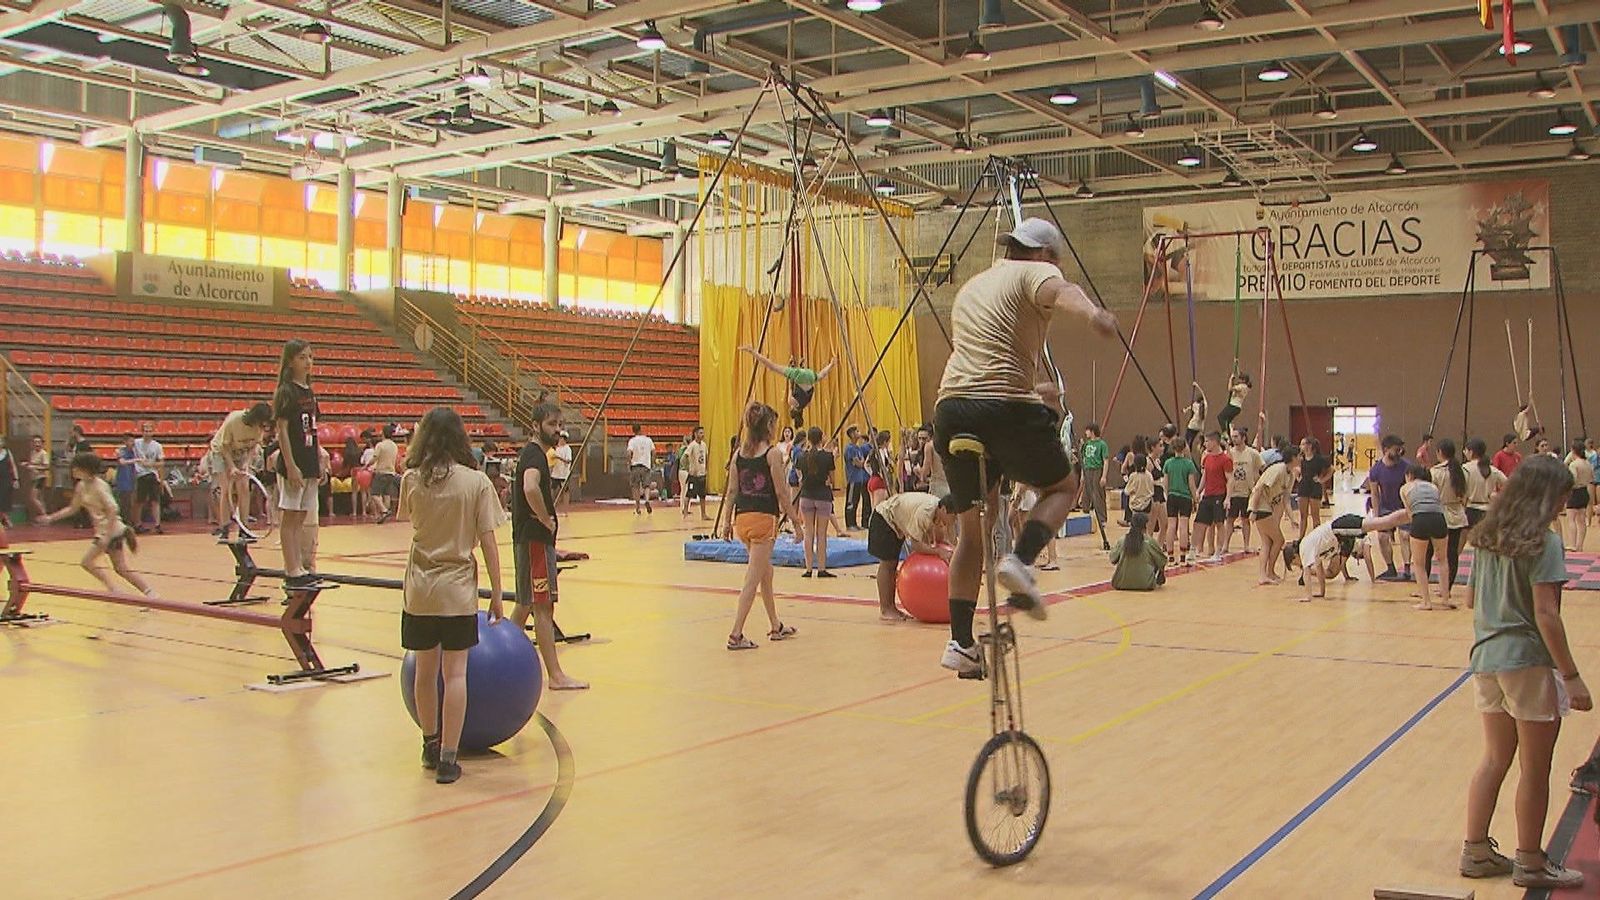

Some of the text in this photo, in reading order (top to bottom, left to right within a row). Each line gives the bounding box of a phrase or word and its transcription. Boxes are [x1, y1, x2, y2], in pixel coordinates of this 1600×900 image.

[1269, 200, 1418, 221] Ayuntamiento de Alcorcón
[1251, 216, 1422, 261] GRACIAS
[168, 260, 264, 282] Ayuntamiento
[1282, 260, 1341, 271] DEPORTISTAS
[1350, 257, 1384, 268] CLUBES
[174, 281, 259, 302] de Alcorcón
[1238, 273, 1306, 293] PREMIO
[1309, 278, 1362, 290] FOMENTO
[1365, 276, 1386, 288] DEL
[1389, 275, 1440, 287] DEPORTE
